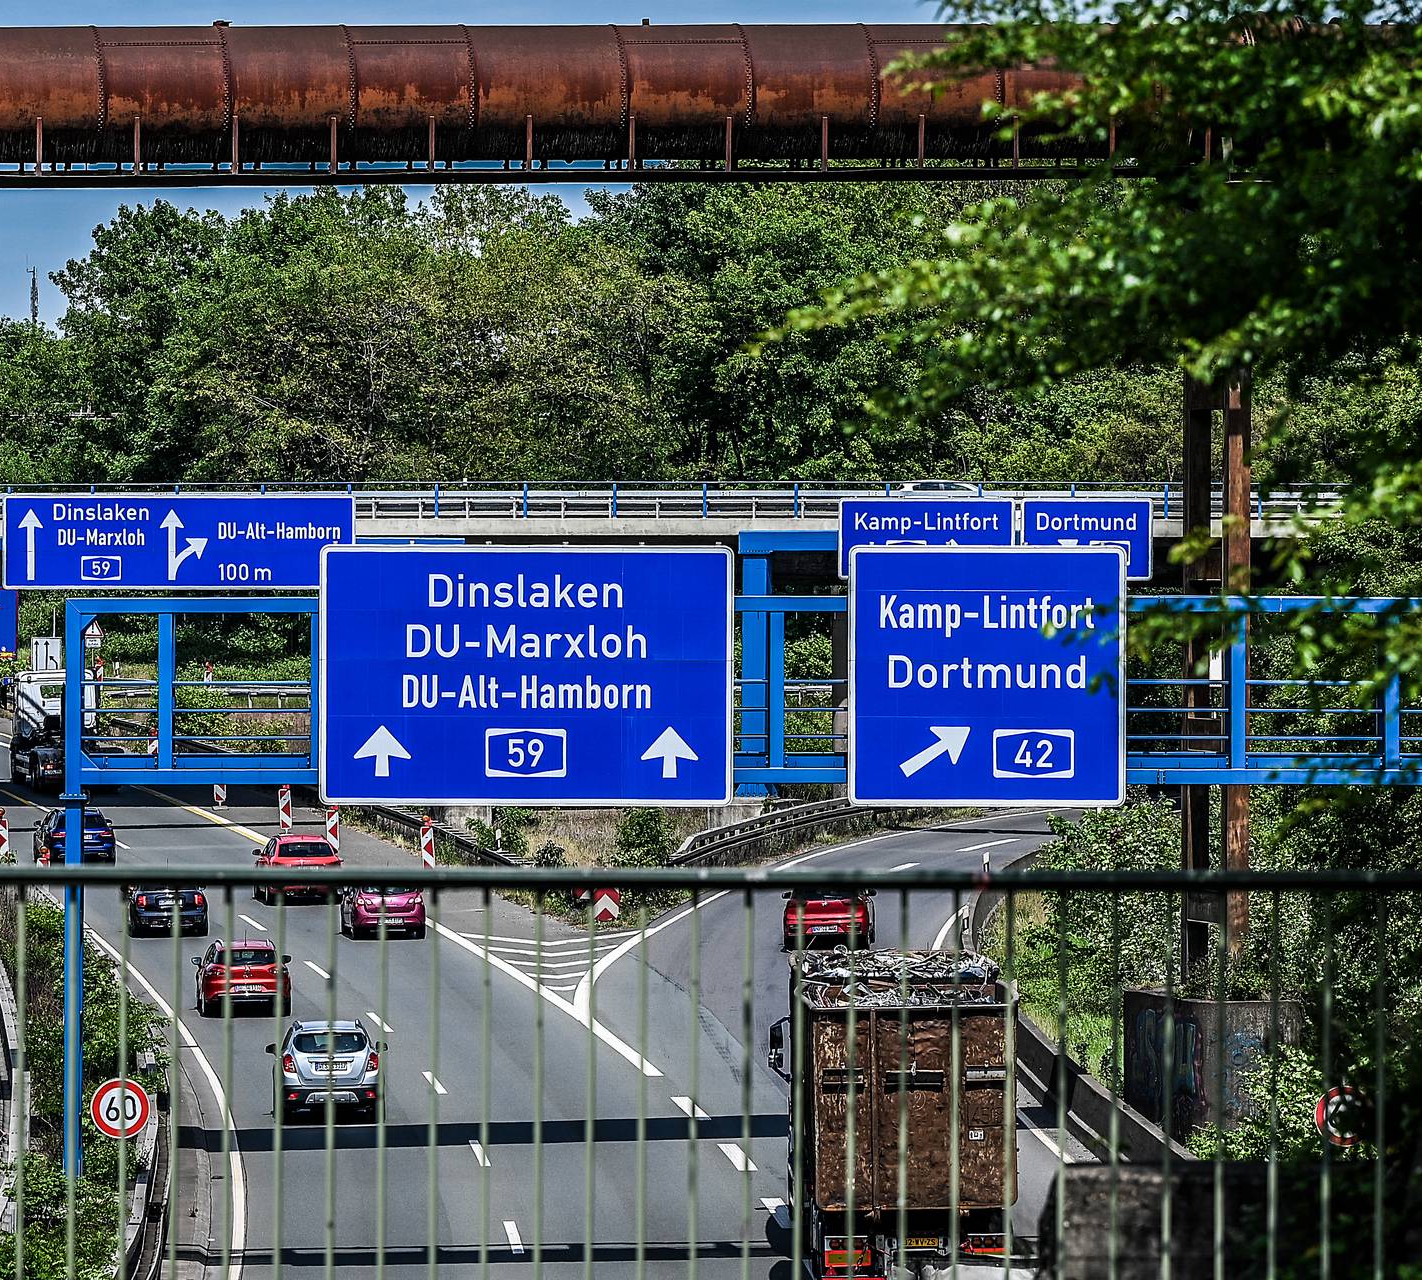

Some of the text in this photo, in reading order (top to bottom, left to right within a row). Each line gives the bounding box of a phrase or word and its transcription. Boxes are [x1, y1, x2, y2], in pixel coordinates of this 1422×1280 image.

[53, 503, 150, 521] Dinslaken
[855, 512, 999, 534] Kamp-Lintfort
[1036, 512, 1137, 531] Dortmund
[57, 528, 145, 546] DU-Marxloh
[218, 521, 341, 540] DU-Alt-Hamborn
[91, 561, 111, 576] 59
[218, 563, 272, 581] 100 m
[428, 573, 623, 608] Dinslaken
[879, 594, 1095, 637] Kamp-Lintfort
[406, 624, 647, 659] DU-Marxloh
[888, 655, 1086, 689] Dortmund
[402, 674, 651, 709] DU-Alt-Hamborn
[508, 738, 544, 768] 59
[1014, 739, 1054, 768] 42
[105, 1095, 137, 1121] 60
